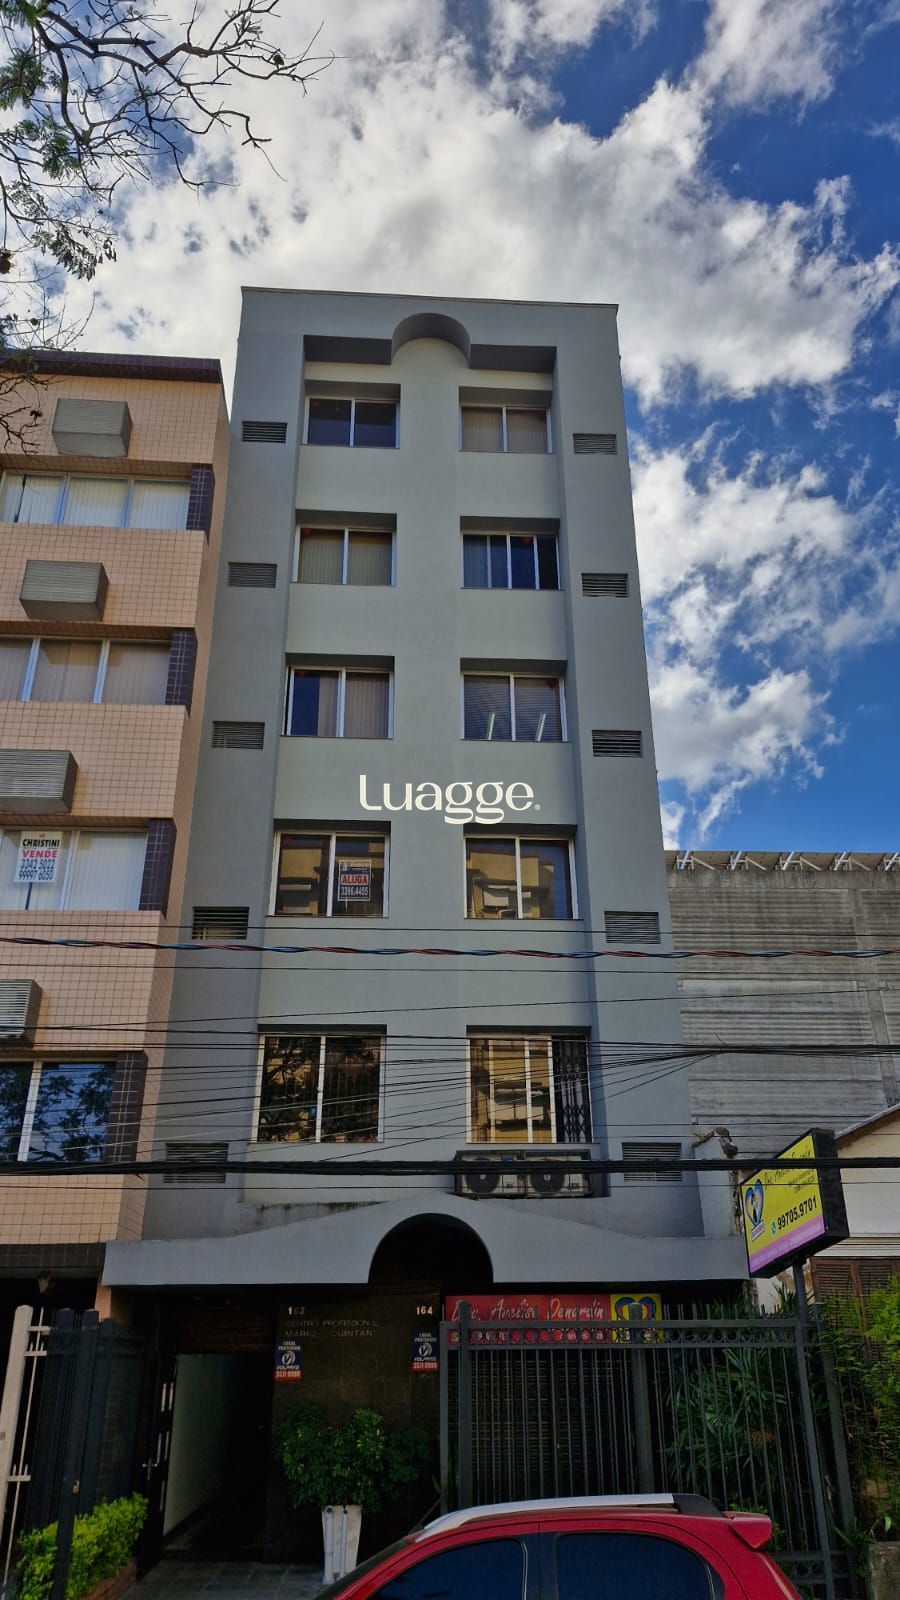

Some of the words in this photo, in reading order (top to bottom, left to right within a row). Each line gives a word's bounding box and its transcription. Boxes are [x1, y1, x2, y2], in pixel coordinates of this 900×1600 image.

[22, 839, 60, 847] CHRISTINI
[22, 850, 58, 858] VENDE
[341, 875, 368, 884] ALUGA
[777, 1195, 817, 1230] 99705.9701
[416, 1306, 433, 1315] 164
